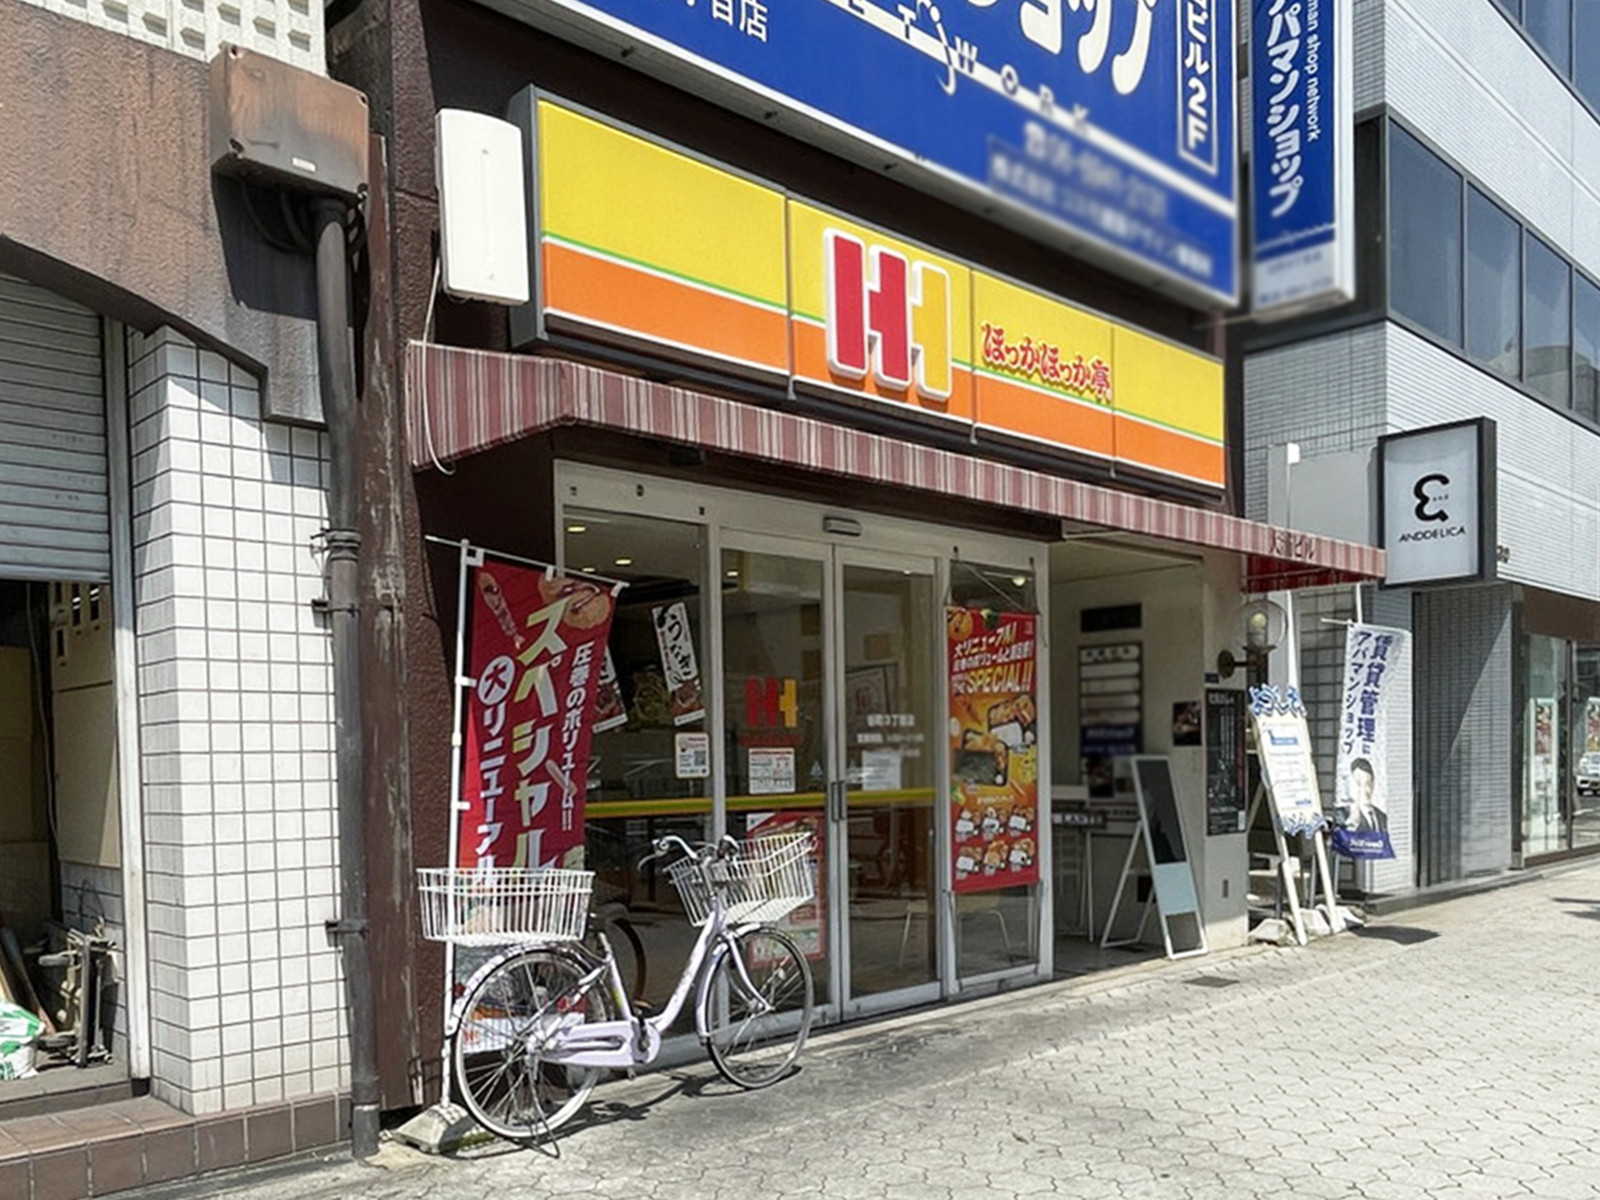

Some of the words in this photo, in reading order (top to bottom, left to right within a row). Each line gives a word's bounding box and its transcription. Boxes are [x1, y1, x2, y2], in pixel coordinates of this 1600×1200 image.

[1306, 34, 1322, 75] shop
[1306, 76, 1321, 142] network
[981, 322, 1111, 395] ほっかほっか亭
[1399, 526, 1466, 542] ANDDELICA
[1343, 631, 1372, 755] アパマンショップ
